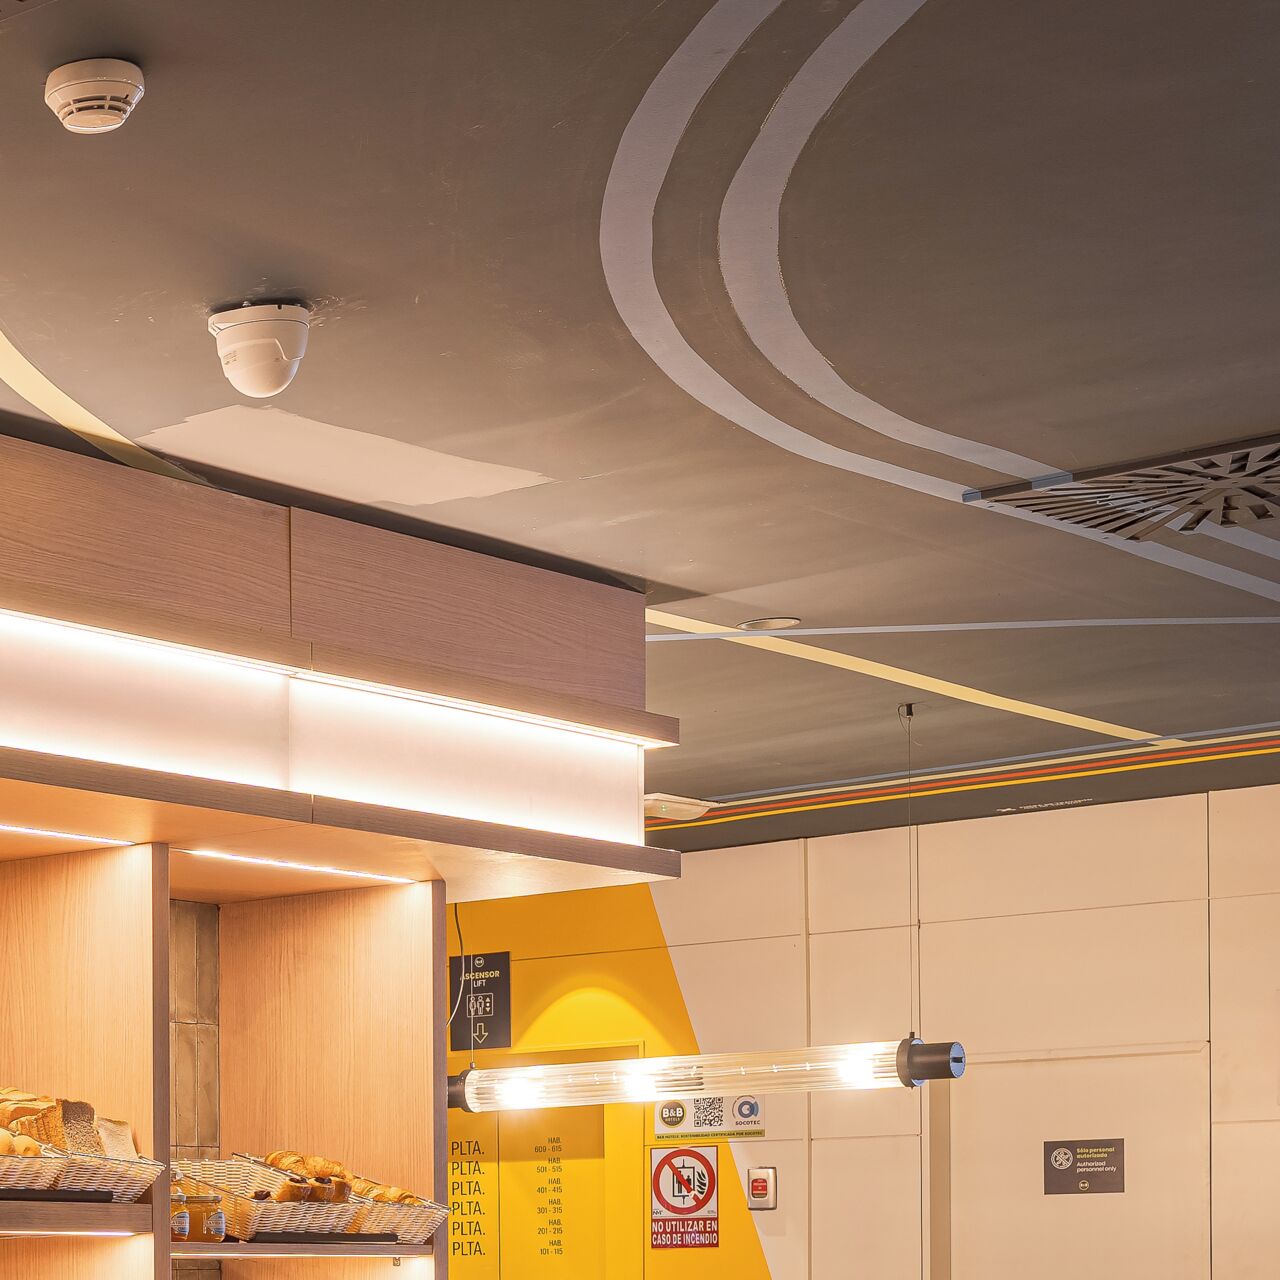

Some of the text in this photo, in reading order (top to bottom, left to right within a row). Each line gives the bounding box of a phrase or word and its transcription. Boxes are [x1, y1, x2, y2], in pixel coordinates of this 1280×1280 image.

[473, 980, 486, 988] LIFT
[662, 1107, 684, 1118] B&B
[452, 1140, 485, 1156] PLTA.
[452, 1160, 485, 1176] PLTA.
[452, 1181, 485, 1196] PLTA.
[452, 1201, 486, 1216] PLTA.
[452, 1221, 486, 1236] PLTA.
[652, 1220, 718, 1232] NO UTILIZAR EN
[652, 1233, 718, 1244] CASO DE INCENDIO
[452, 1241, 486, 1256] PLTA.
